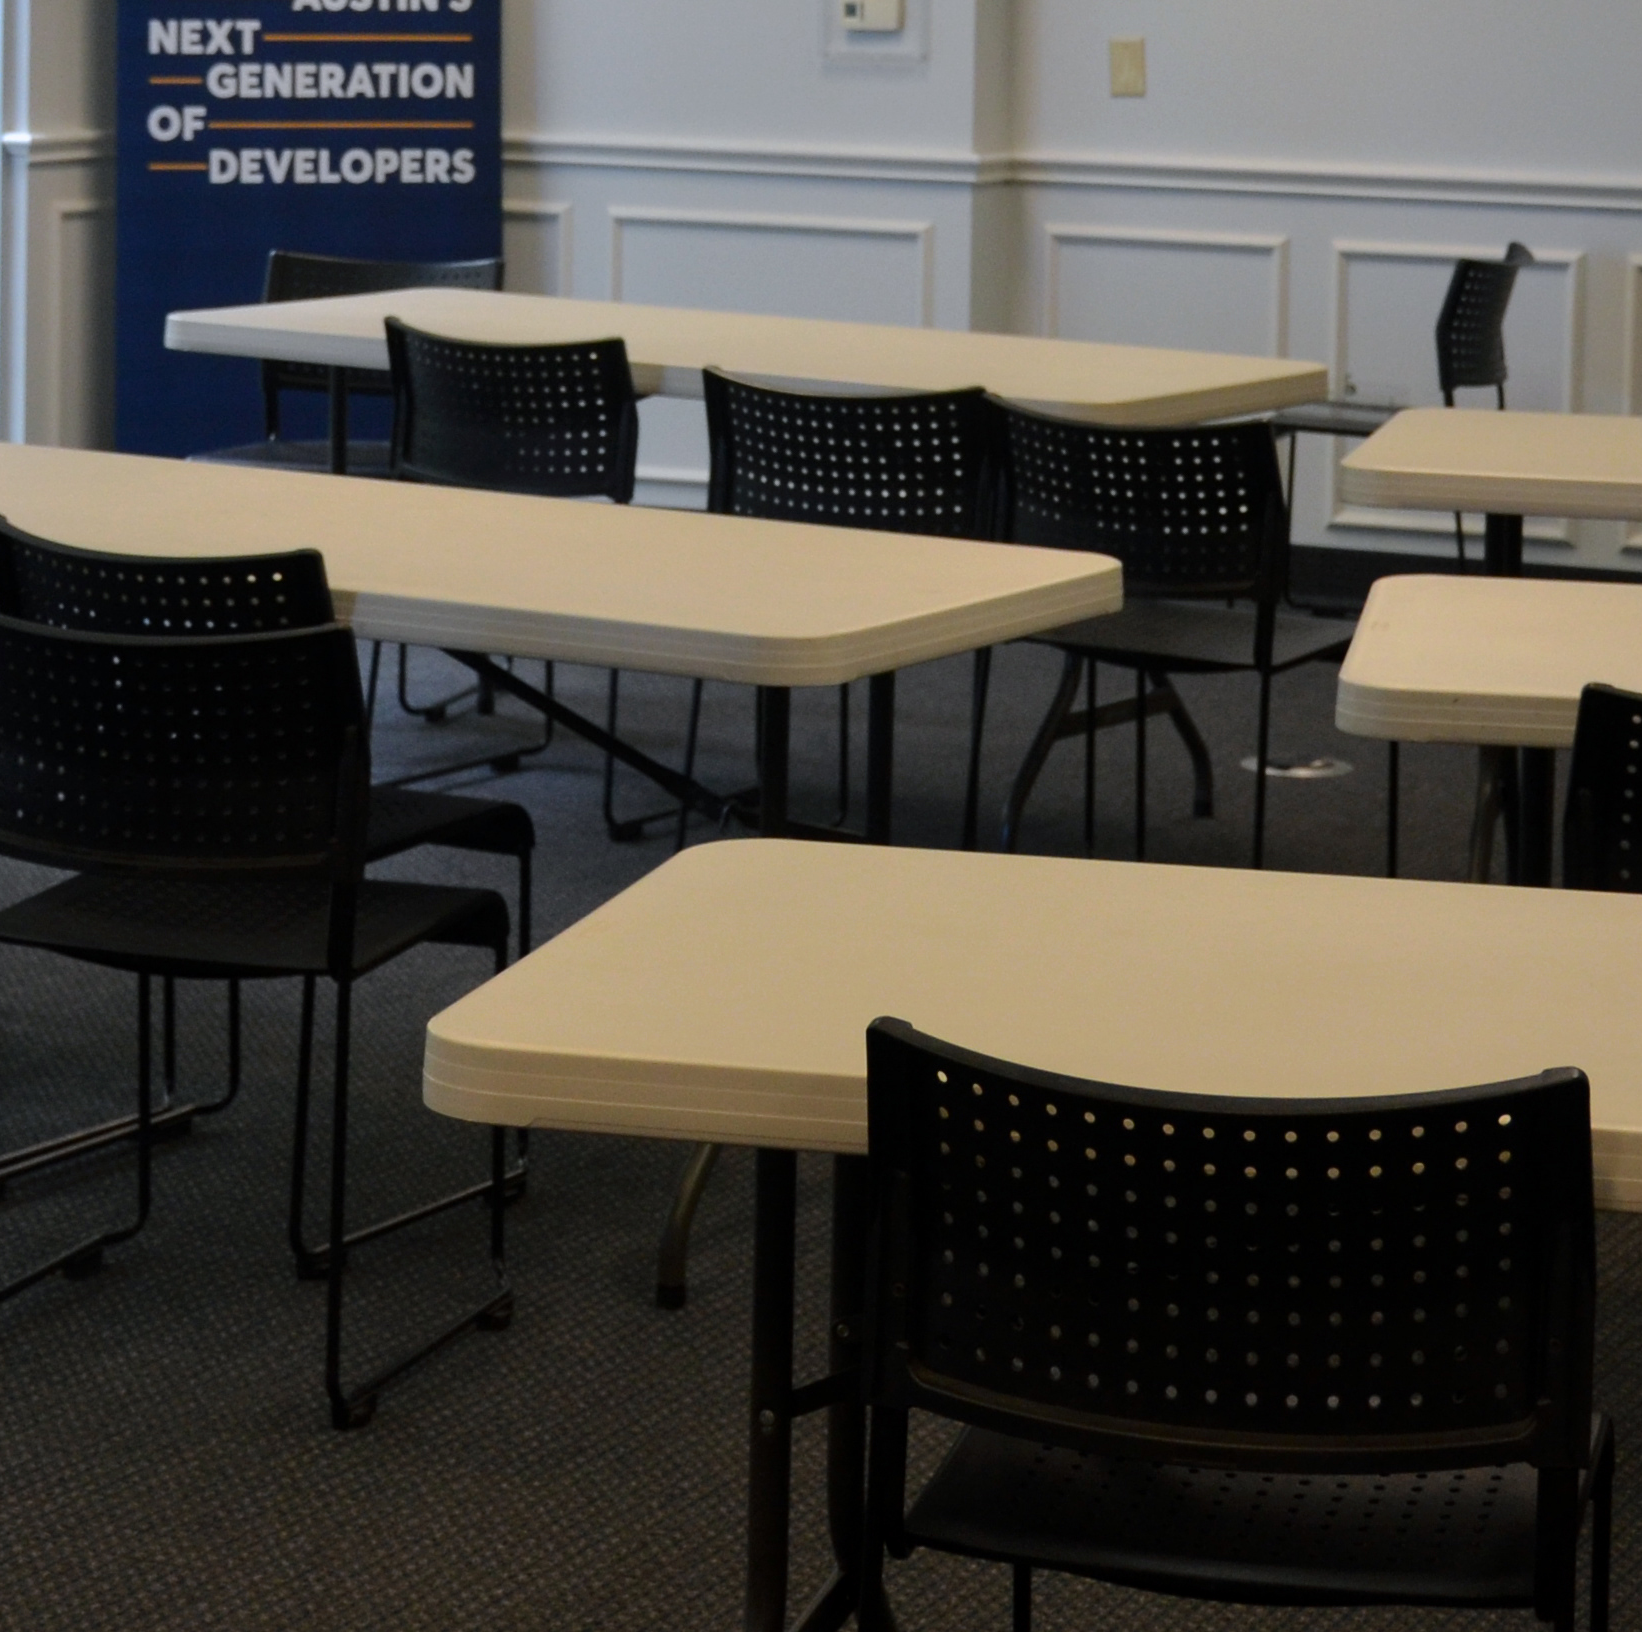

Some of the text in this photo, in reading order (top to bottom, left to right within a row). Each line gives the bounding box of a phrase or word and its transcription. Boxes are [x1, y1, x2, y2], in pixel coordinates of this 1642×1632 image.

[148, 19, 261, 54] NEXT
[206, 63, 474, 98] GENERATION
[147, 106, 206, 141] OF
[209, 148, 475, 183] DEVELOPERS
